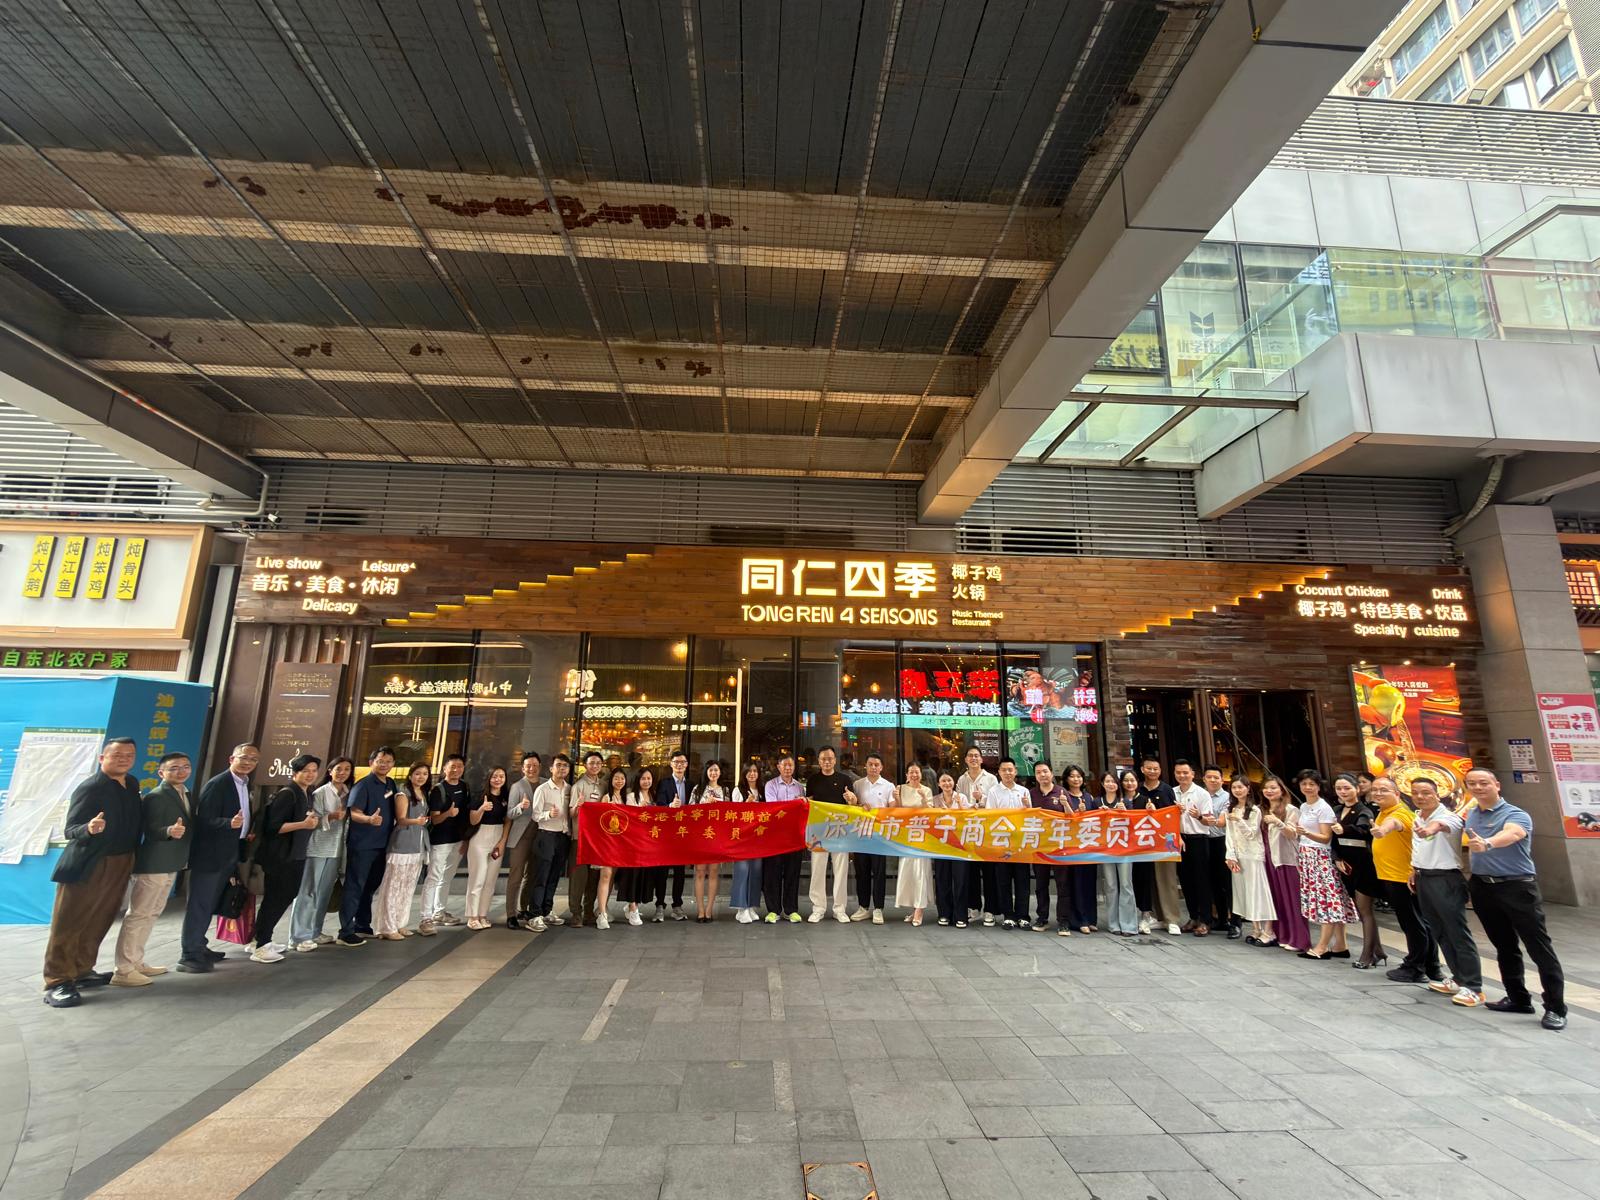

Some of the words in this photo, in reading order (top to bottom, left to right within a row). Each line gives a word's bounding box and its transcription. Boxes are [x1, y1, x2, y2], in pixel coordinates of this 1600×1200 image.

[58, 540, 81, 592] 炖江鱼
[89, 542, 112, 593] 炖笨鸡
[119, 543, 142, 593] 炖骨头
[255, 557, 284, 569] Live
[286, 558, 322, 570] show
[362, 560, 410, 573] Leisure
[741, 558, 937, 598] 同仁四季
[951, 563, 1002, 582] 椰子鸡
[951, 583, 986, 601] 火锅
[1295, 584, 1343, 597] Coconut
[1344, 585, 1390, 598] Chicken
[1432, 588, 1463, 600] Drink
[302, 598, 358, 615] Delicacy
[951, 609, 973, 618] Music
[973, 610, 1004, 619] Themed
[839, 607, 854, 624] 4
[859, 608, 938, 626] SEASONS
[952, 618, 992, 627] Restaurant
[1353, 623, 1407, 638] Specialty
[1413, 625, 1460, 637] cuisine
[2, 649, 130, 669] 自东北农户家
[649, 824, 769, 841] 青年委員會
[824, 814, 1163, 850] 深圳市普宁商会青年委员会
